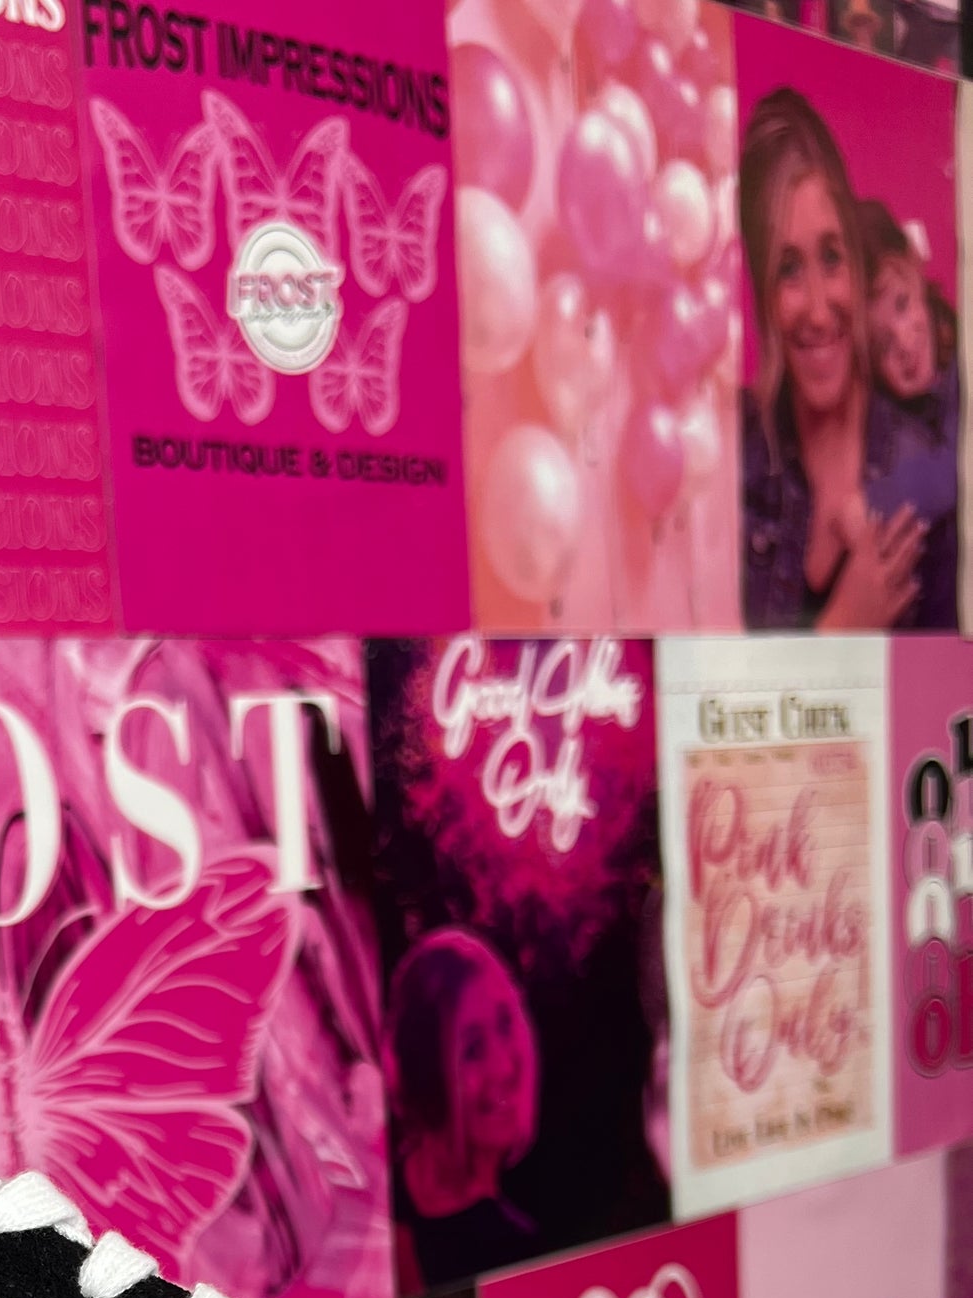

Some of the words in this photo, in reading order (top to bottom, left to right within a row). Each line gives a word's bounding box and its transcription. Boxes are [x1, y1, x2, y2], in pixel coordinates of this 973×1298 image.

[84, 0, 209, 76] FROST
[216, 22, 451, 140] IMPRESSIONS
[132, 434, 304, 479] BOUTIQUE
[309, 449, 334, 478] &
[337, 450, 449, 487] DESIGN
